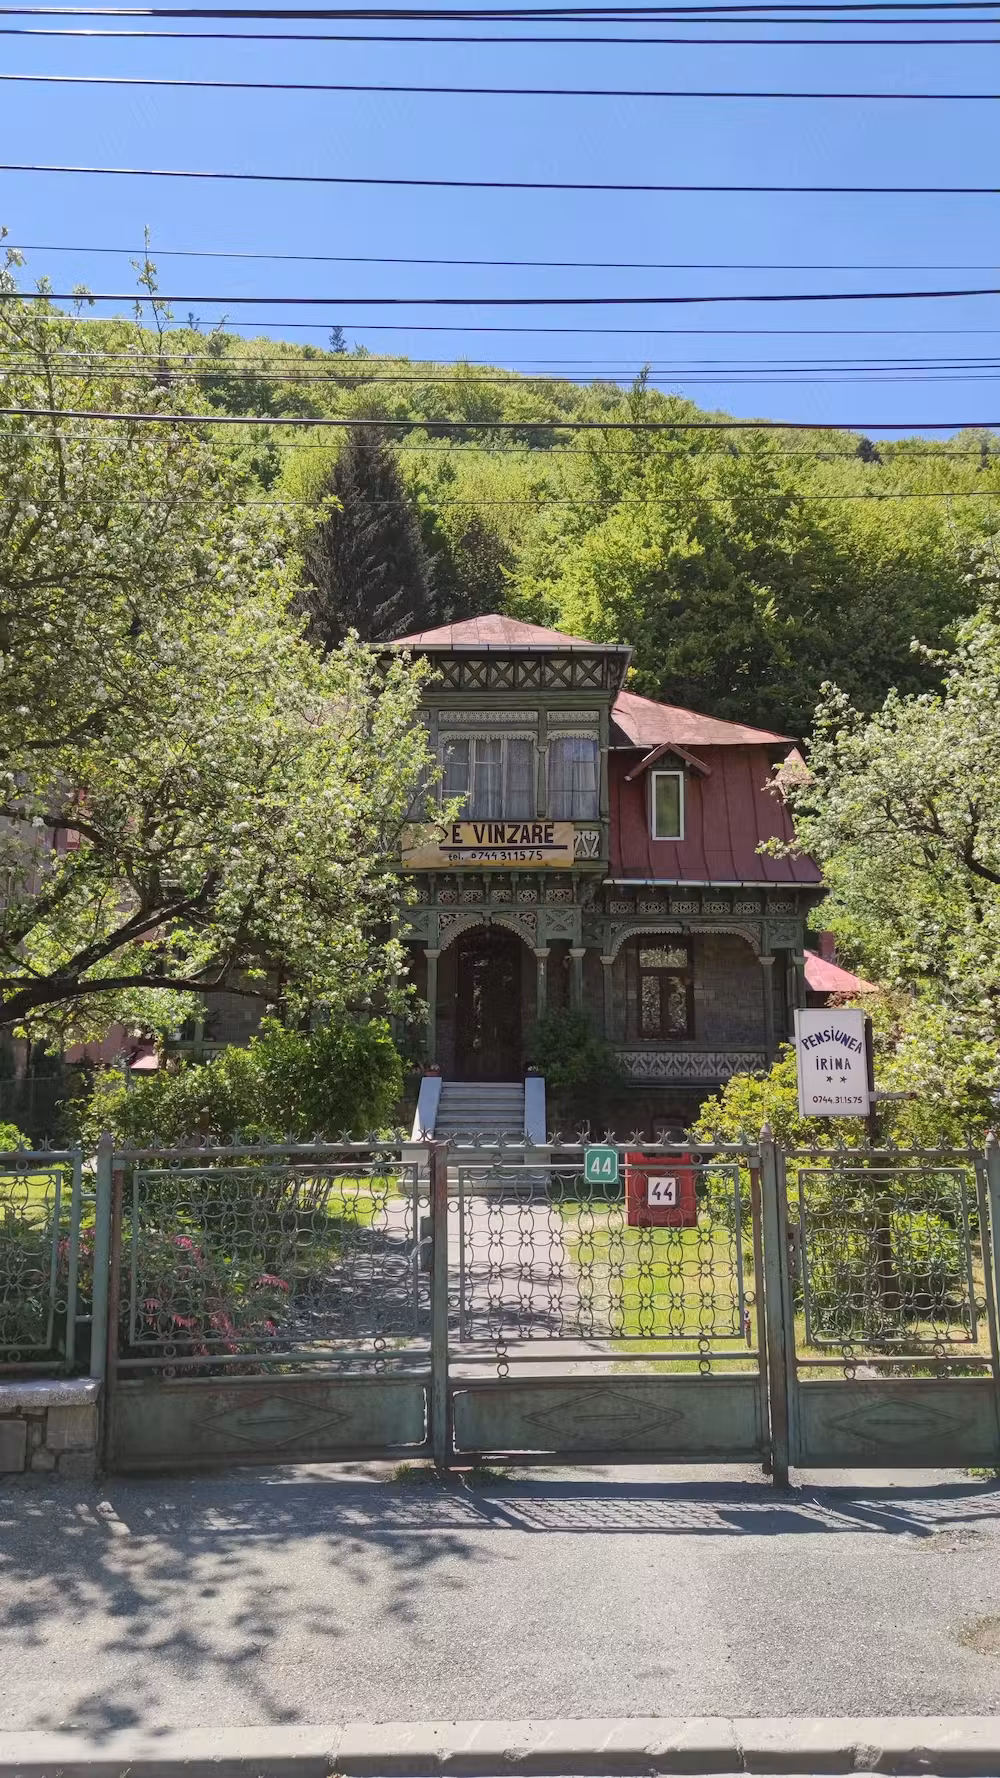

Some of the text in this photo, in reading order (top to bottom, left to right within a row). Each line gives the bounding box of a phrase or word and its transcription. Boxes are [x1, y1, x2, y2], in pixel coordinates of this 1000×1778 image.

[473, 823, 555, 844] VINZARE
[448, 851, 464, 861] tel.
[590, 1156, 612, 1175] 44
[651, 1182, 673, 1202] 44
